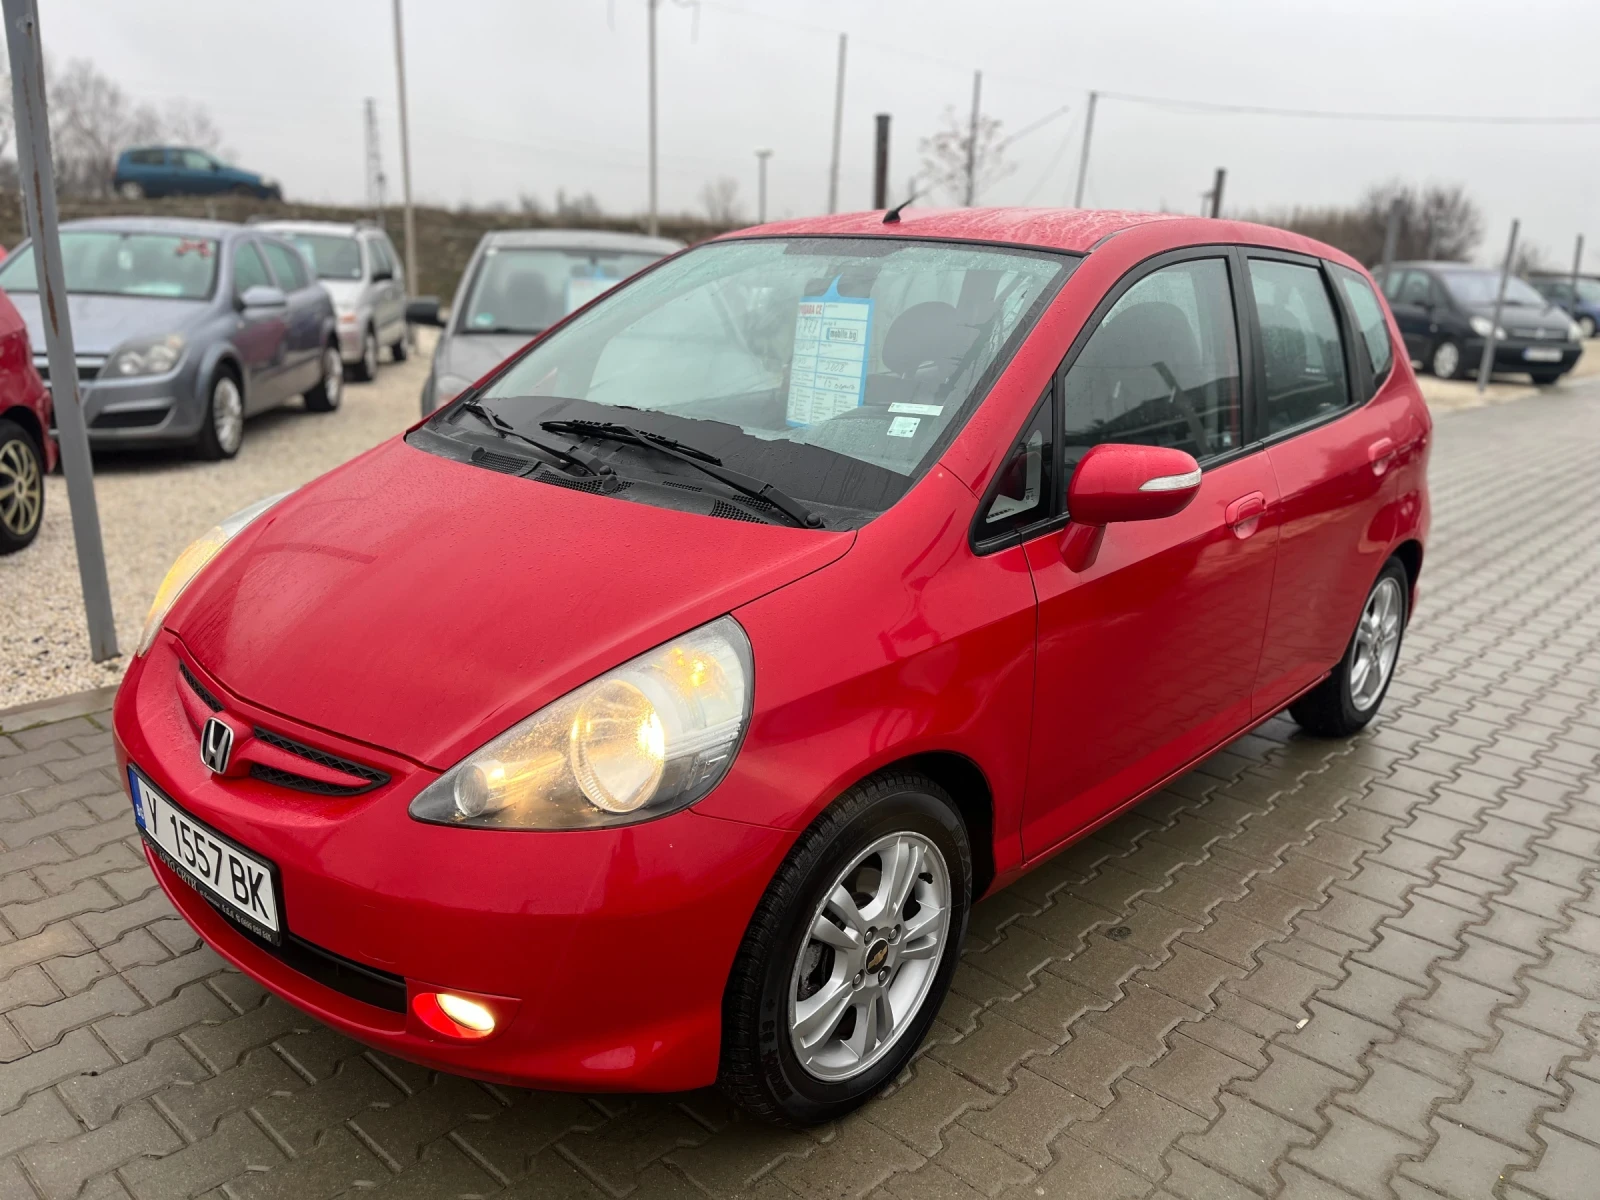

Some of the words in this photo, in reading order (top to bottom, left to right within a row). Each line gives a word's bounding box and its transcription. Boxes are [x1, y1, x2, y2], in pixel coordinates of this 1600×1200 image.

[830, 329, 857, 341] mobile.bg
[169, 813, 223, 886] 1557
[228, 854, 270, 921] BK
